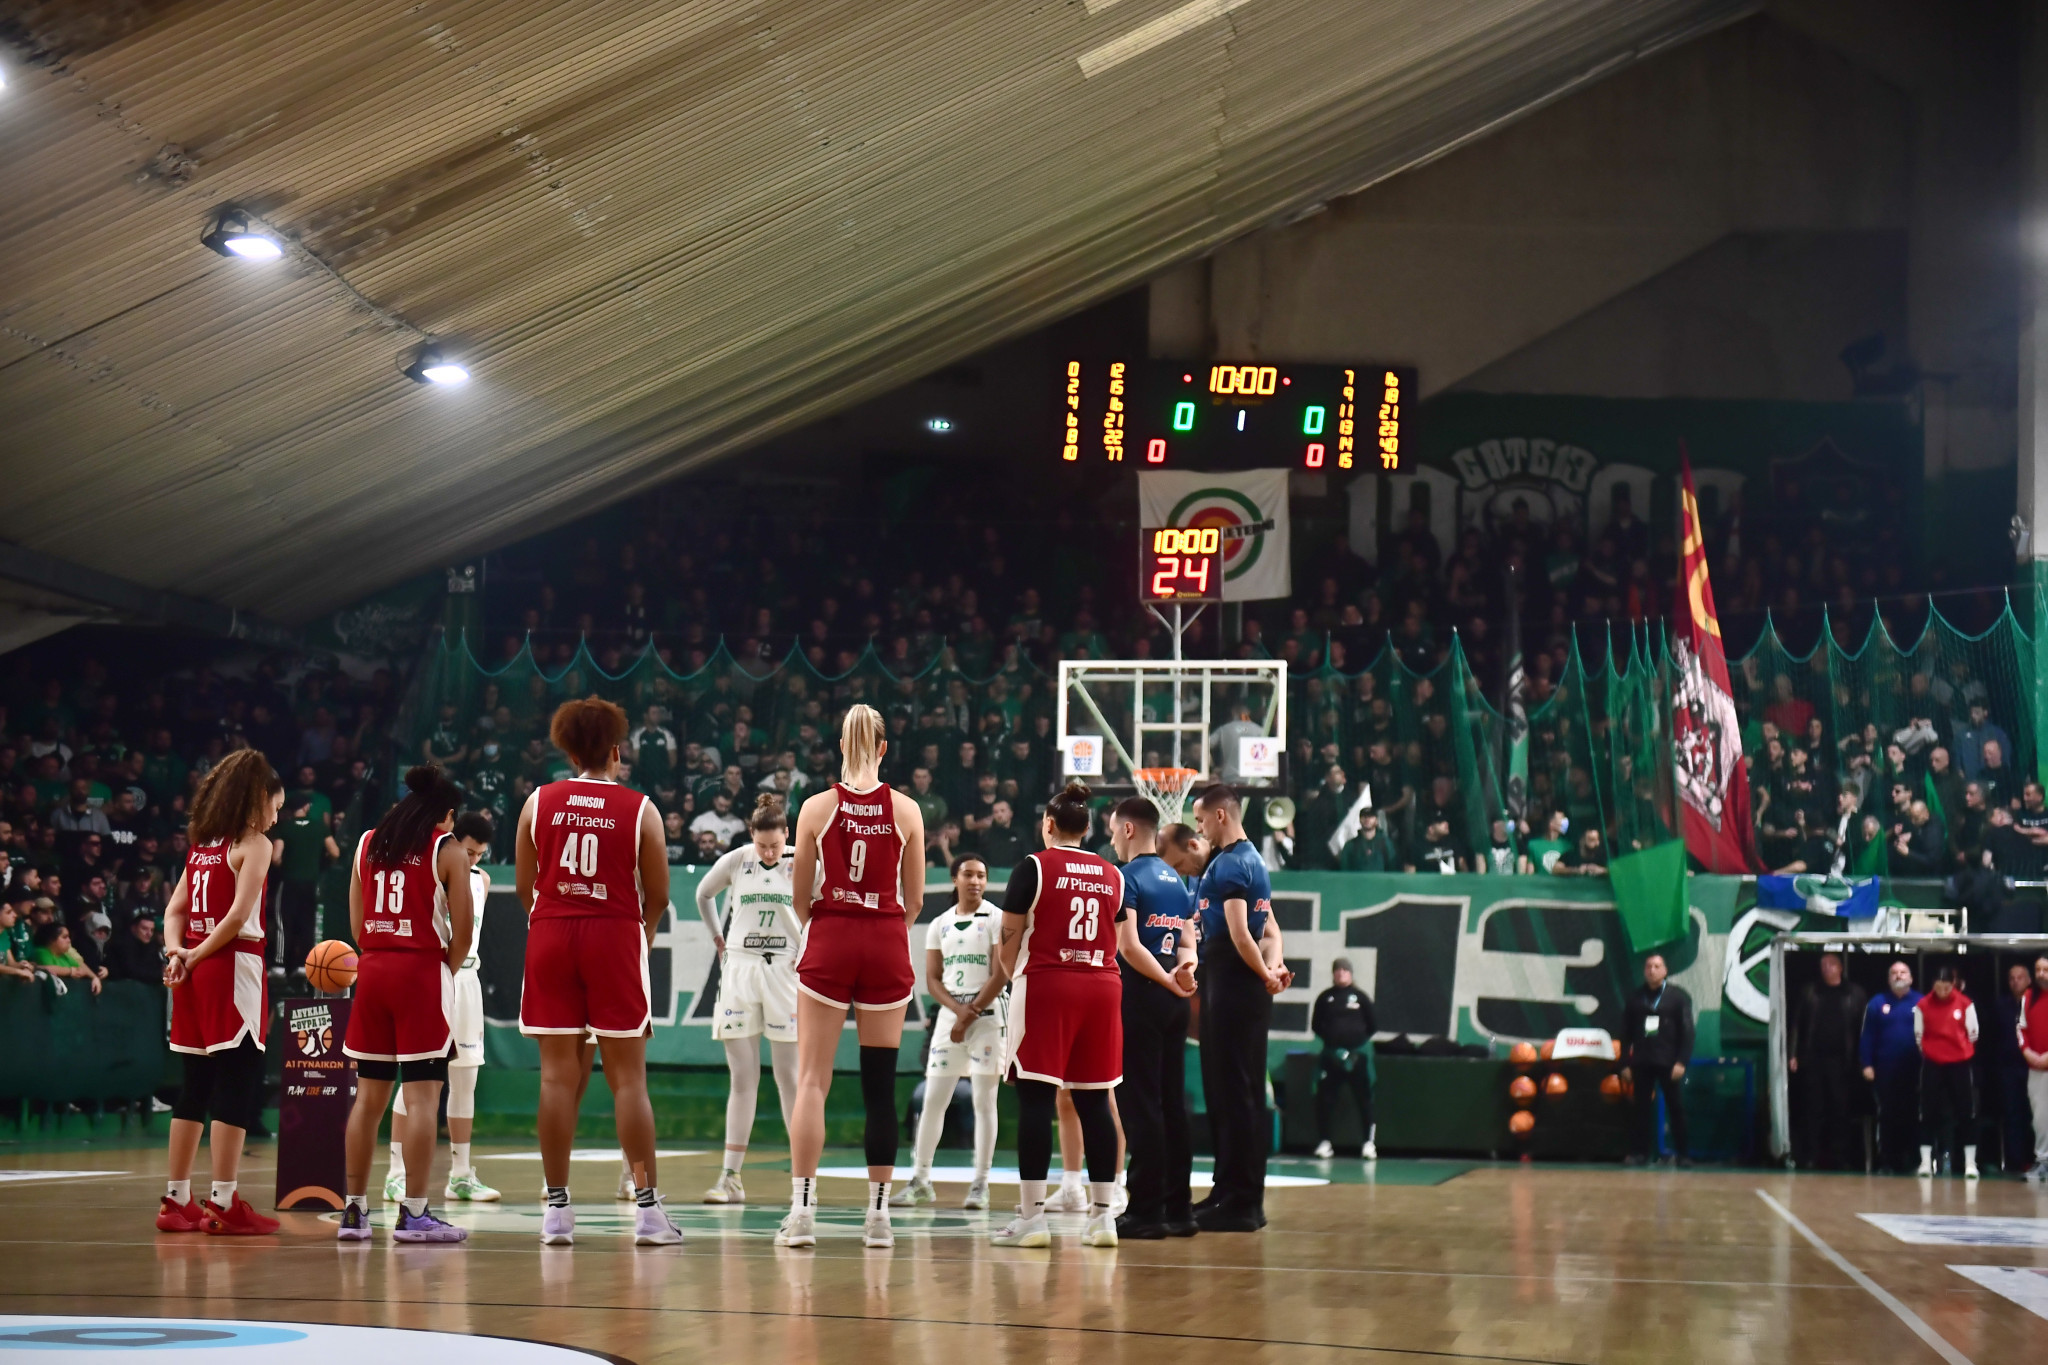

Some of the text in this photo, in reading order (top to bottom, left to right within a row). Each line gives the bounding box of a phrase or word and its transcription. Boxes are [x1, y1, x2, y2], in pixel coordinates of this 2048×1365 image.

[1068, 361, 1079, 377] 0
[1110, 363, 1125, 378] 12
[1344, 369, 1355, 385] 7
[1067, 378, 1079, 394] 2
[1110, 380, 1124, 395] 15
[1209, 366, 1277, 395] 10:00
[1343, 386, 1355, 402] 9
[1384, 387, 1400, 403] 18
[1067, 395, 1079, 410] 4
[1339, 403, 1354, 418] 11
[1066, 412, 1078, 427] 6
[1173, 402, 1195, 431] 0
[1378, 403, 1399, 420] 21
[1103, 412, 1124, 428] 21
[1237, 409, 1246, 432] 1
[1303, 405, 1325, 435] 0
[1338, 419, 1354, 436] 13
[1066, 428, 1079, 444] 8
[1378, 420, 1399, 437] 23
[1103, 429, 1124, 445] 22
[1338, 436, 1354, 451] 14
[1378, 437, 1399, 453] 40
[1063, 444, 1078, 461] 10
[1105, 446, 1124, 461] 77
[1147, 439, 1166, 463] 0
[1305, 443, 1325, 467] 0
[1338, 452, 1353, 469] 15
[1380, 453, 1399, 469] 77
[1153, 528, 1220, 555] 10:00
[1152, 557, 1210, 594] 24
[566, 794, 605, 809] JOHNSON
[566, 812, 616, 830] Piraeus
[846, 819, 892, 835] Piraeus
[560, 832, 599, 877] 40
[849, 839, 867, 883] 9
[191, 870, 211, 913] 21
[374, 869, 405, 914] 13
[1070, 878, 1114, 896] Piraeus
[758, 910, 776, 928] 77
[1068, 896, 1100, 942] 23
[956, 970, 964, 987] 2
[319, 1017, 327, 1027] 13
[297, 1060, 344, 1069] ΓΥΝΑΙΚΩΝ
[287, 1085, 306, 1096] PLAY
